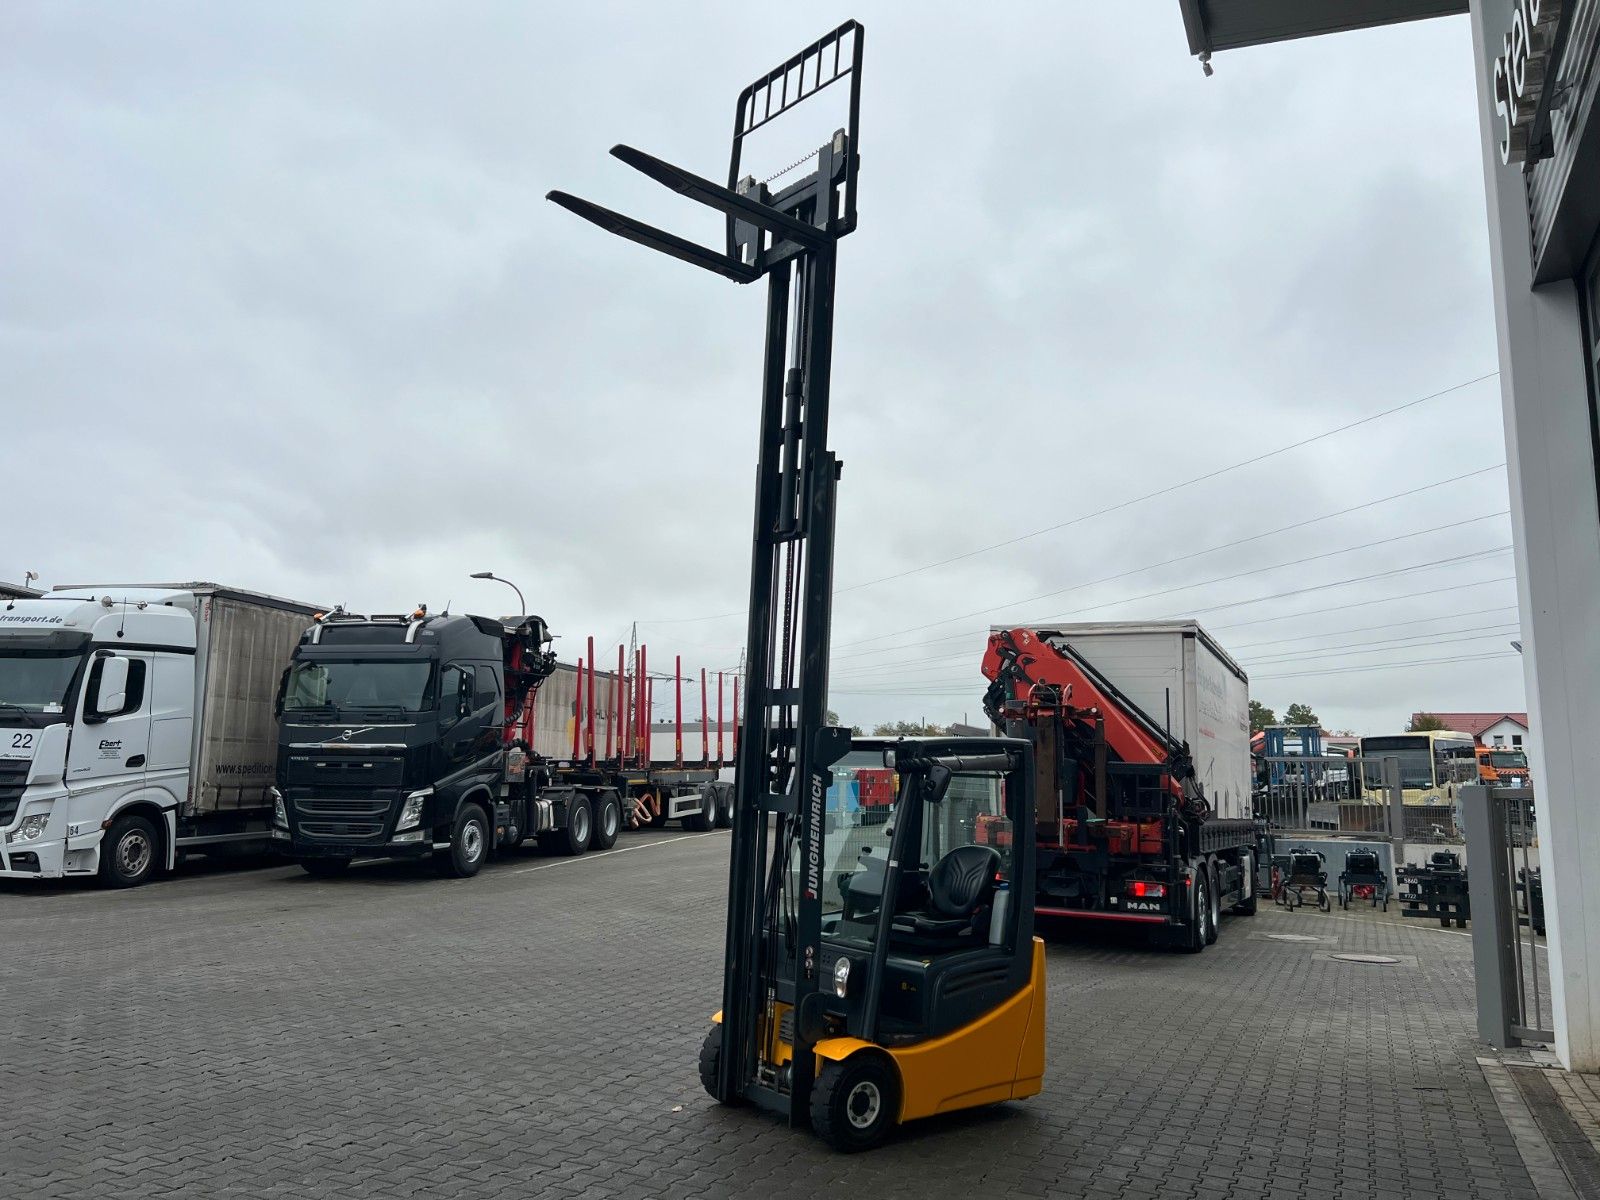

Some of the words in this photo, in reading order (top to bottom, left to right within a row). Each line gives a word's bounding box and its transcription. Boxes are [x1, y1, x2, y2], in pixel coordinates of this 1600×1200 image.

[12, 733, 33, 748] 22
[805, 774, 822, 900] JUNGHEINRICH
[1127, 902, 1160, 910] MAN
